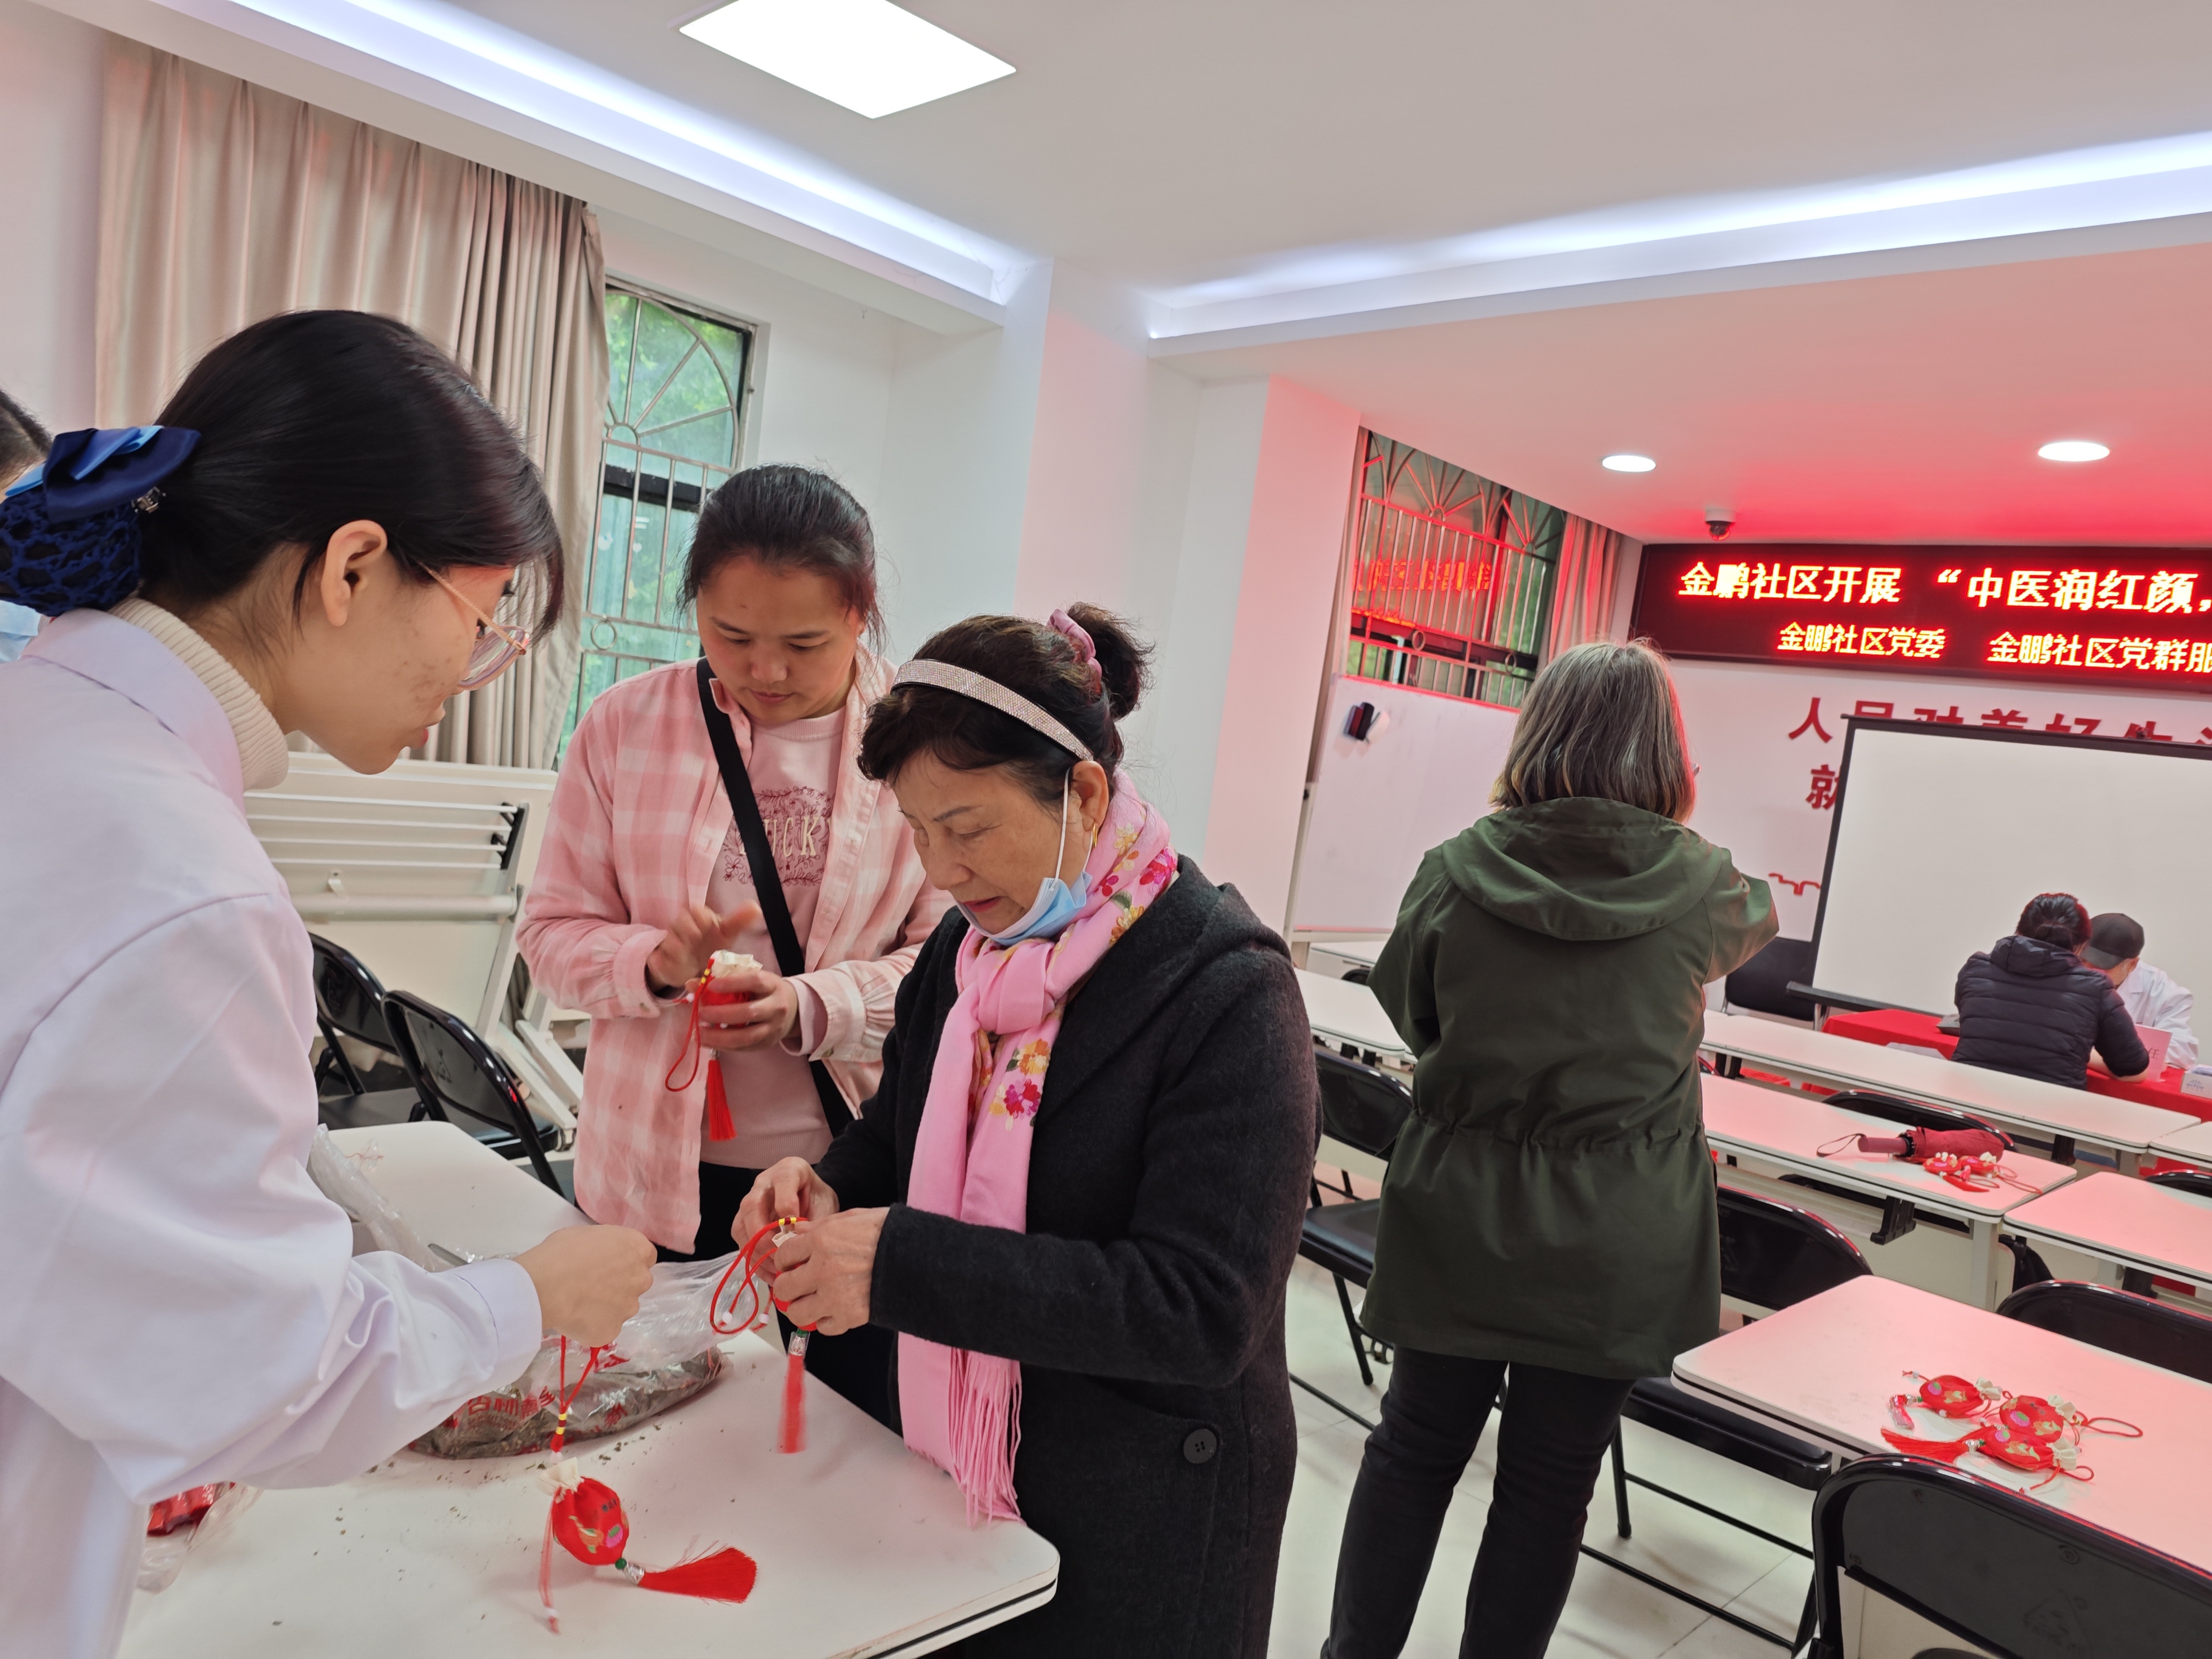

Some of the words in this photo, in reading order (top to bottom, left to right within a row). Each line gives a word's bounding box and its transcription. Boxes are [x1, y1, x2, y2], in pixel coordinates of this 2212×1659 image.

[1678, 561, 1901, 603] 金鹏社区开展
[1778, 622, 1946, 659] 金鹏社区党委
[739, 816, 832, 858] UCK
